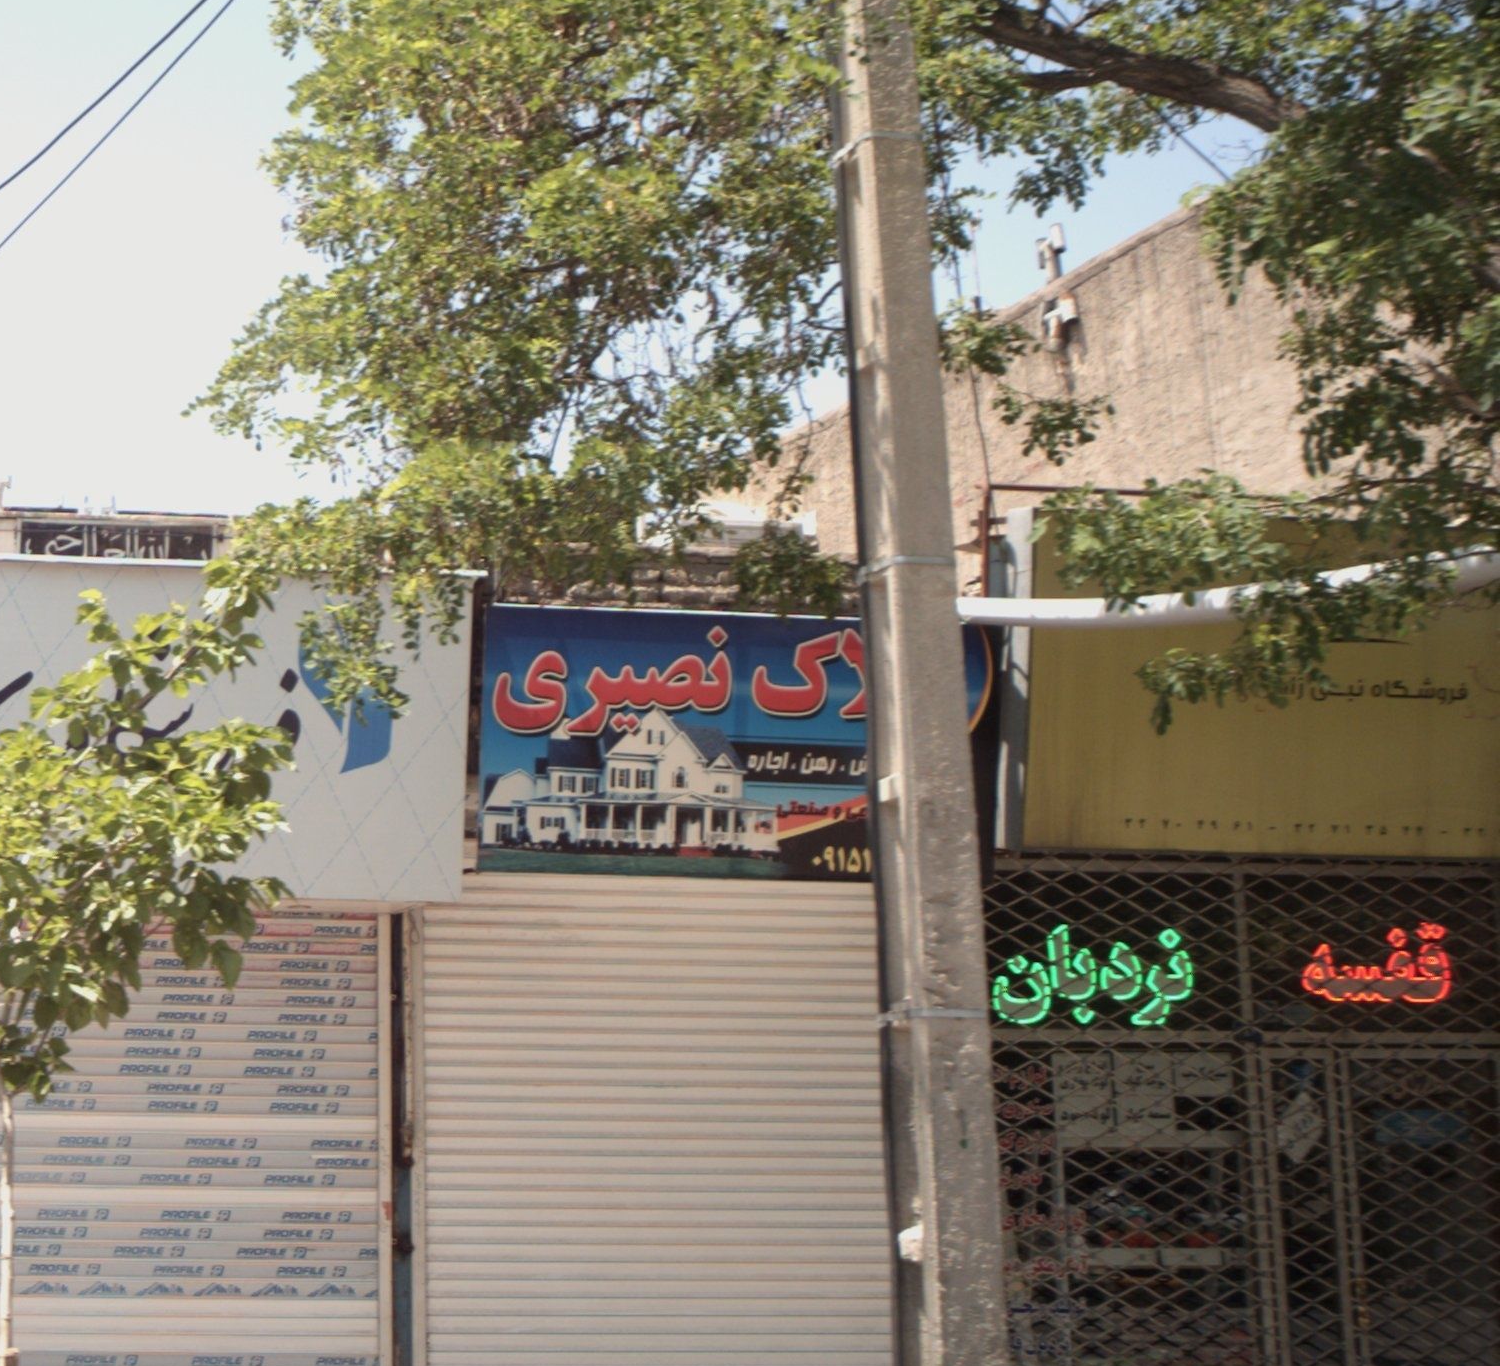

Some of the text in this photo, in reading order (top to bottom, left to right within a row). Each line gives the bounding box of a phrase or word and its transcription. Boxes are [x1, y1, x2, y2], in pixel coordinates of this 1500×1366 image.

[493, 626, 733, 735] نصیری
[748, 750, 790, 775] اجاره
[800, 752, 837, 775] رهن
[811, 845, 873, 874] ۰۹۱۵۱
[312, 925, 363, 935] PROFILE
[279, 961, 328, 971] PROFILE
[1302, 921, 1452, 1004] قفسه
[157, 975, 208, 985] PROFILE
[280, 977, 331, 987] PROFILE
[990, 923, 1195, 1027] نردبان
[164, 993, 215, 1003] PROFILE
[285, 995, 336, 1005] PROFILE
[157, 1011, 208, 1021] PROFILE
[277, 1013, 328, 1023] PROFILE
[125, 1028, 176, 1038] PROFILE
[247, 1030, 298, 1040] PROFILE
[127, 1046, 182, 1056] PROFILE
[254, 1048, 305, 1058] PROFILE
[120, 1064, 171, 1074] PROFILE
[244, 1066, 295, 1076] PROFILE
[147, 1082, 201, 1092] PROFILE
[278, 1084, 329, 1094] PROFILE
[148, 1100, 199, 1110] PROFILE
[269, 1102, 320, 1112] PROFILE
[59, 1136, 110, 1146] PROFILE
[186, 1137, 237, 1147] PROFILE
[312, 1139, 363, 1149] PROFILE
[42, 1154, 106, 1164] PROFILE
[189, 1156, 240, 1166] PROFILE
[315, 1157, 370, 1167] PROFILE
[141, 1173, 192, 1183] PROFILE
[265, 1174, 316, 1184] PROFILE
[38, 1208, 89, 1218] PROFILE
[161, 1209, 211, 1219] PROFILE
[282, 1210, 332, 1220] PROFILE
[16, 1226, 67, 1236] PROFILE
[140, 1228, 191, 1238] PROFILE
[263, 1228, 313, 1238] PROFILE
[114, 1245, 165, 1255] PROFILE
[237, 1246, 287, 1256] PROFILE
[29, 1263, 80, 1273] PROFILE
[154, 1264, 204, 1274] PROFILE
[276, 1266, 327, 1276] PROFILE
[67, 1354, 118, 1364] PROFILE
[192, 1355, 242, 1365] PROFILE
[316, 1357, 365, 1366] PROFILE
